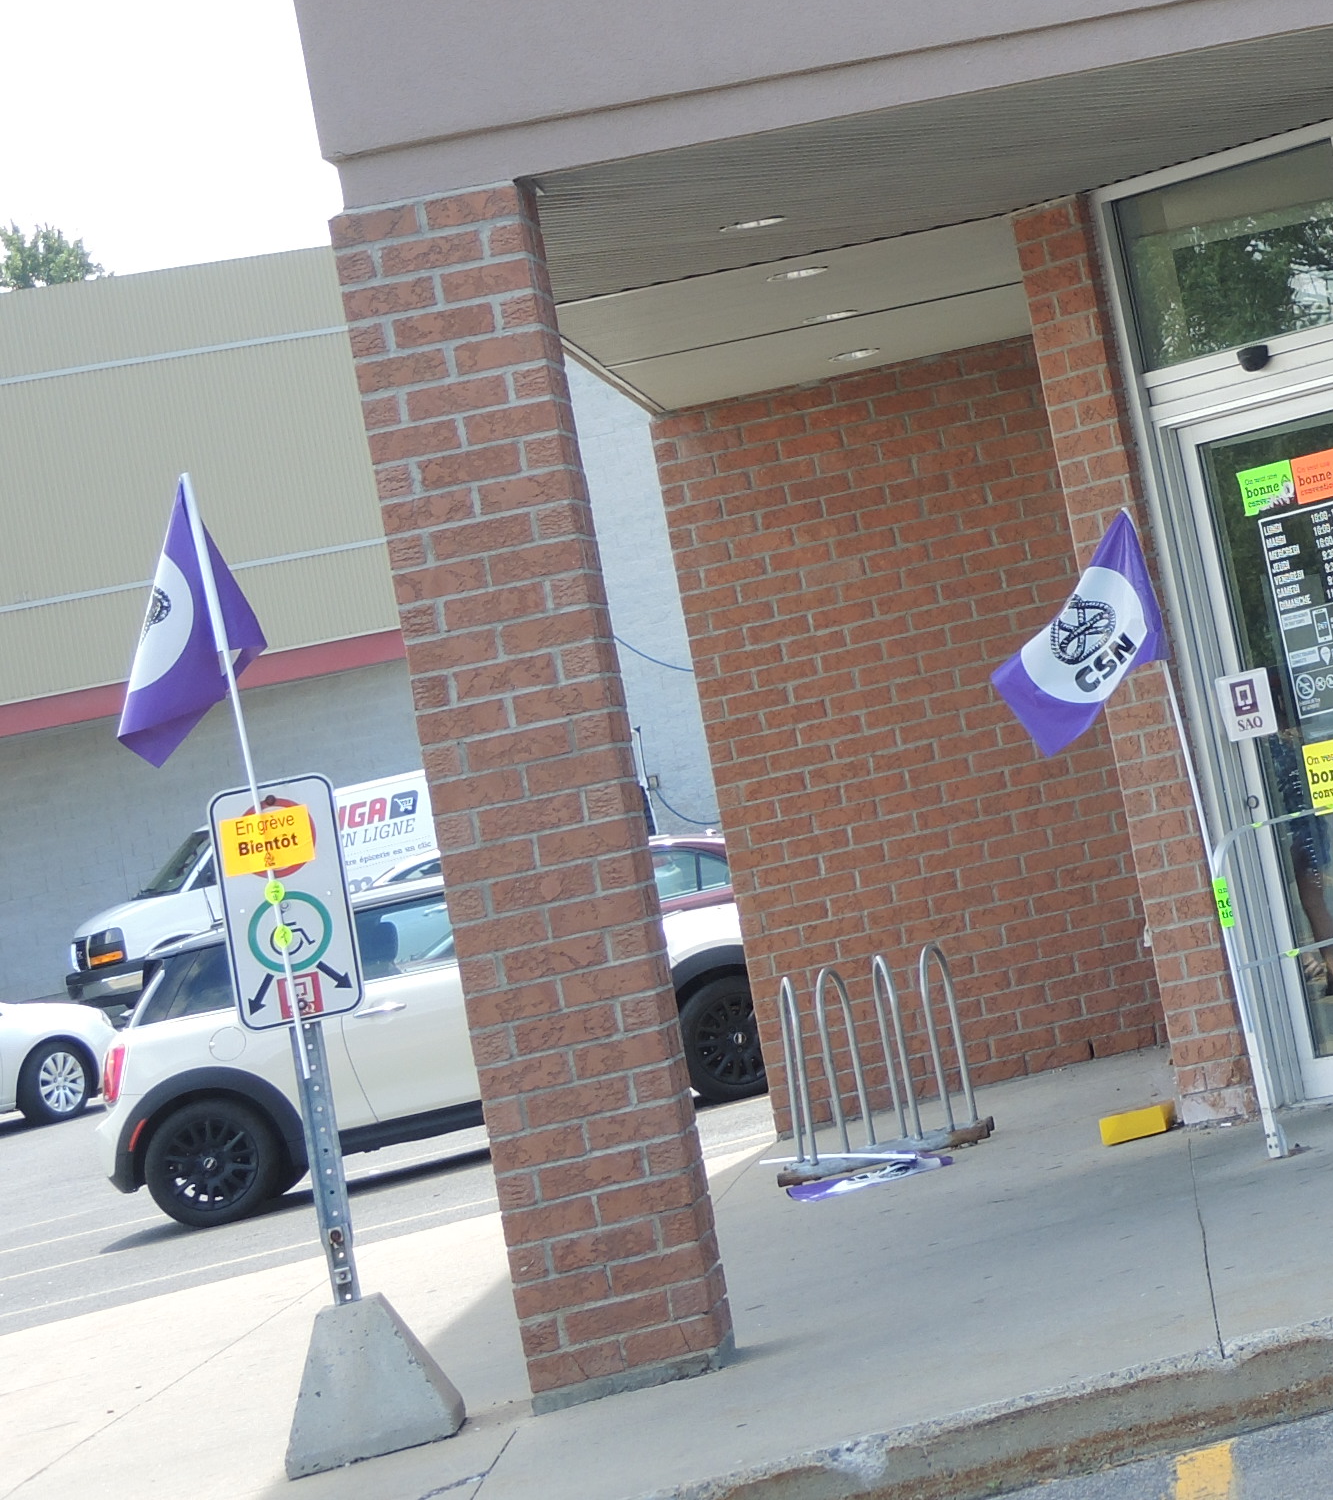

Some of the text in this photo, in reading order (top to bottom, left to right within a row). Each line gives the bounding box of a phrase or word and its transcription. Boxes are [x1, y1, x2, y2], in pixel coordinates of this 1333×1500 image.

[1297, 471, 1332, 487] bonne
[1245, 483, 1280, 499] bonne
[1075, 632, 1137, 693] CSN
[1237, 716, 1263, 731] SAQ
[1306, 755, 1319, 766] On
[235, 813, 294, 836] En grève
[337, 797, 387, 831] IGA
[363, 818, 416, 844] LIGNE
[238, 833, 298, 856] Bientôt
